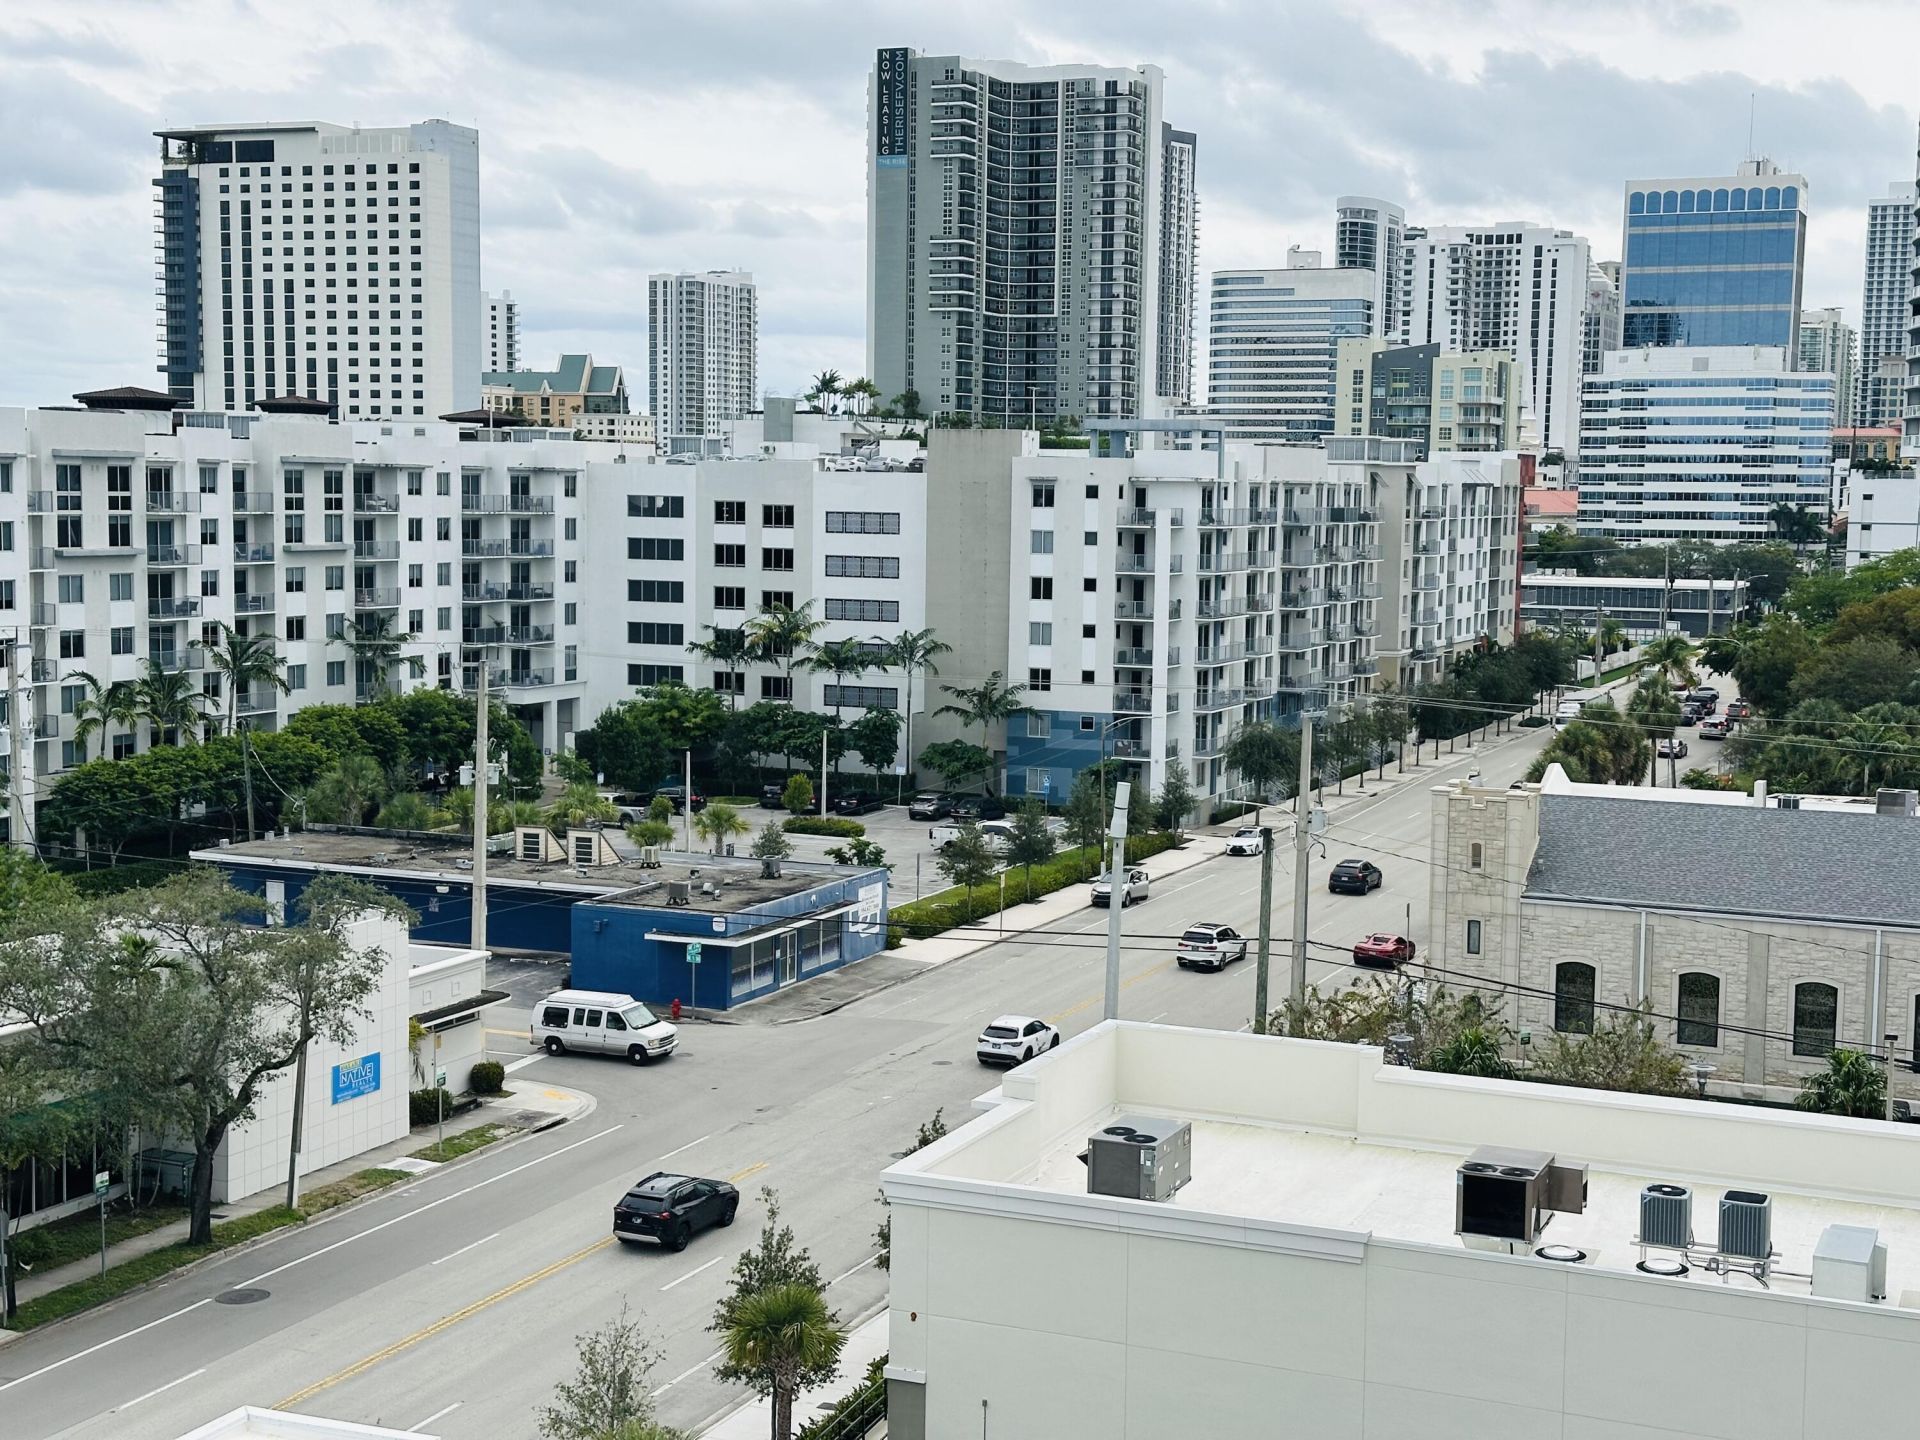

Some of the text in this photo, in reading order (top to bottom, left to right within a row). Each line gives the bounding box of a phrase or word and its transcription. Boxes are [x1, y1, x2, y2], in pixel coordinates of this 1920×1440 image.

[881, 50, 891, 155] NOW LEASING
[895, 50, 904, 153] THERISEFV.COM
[341, 1065, 372, 1084] NATIVE
